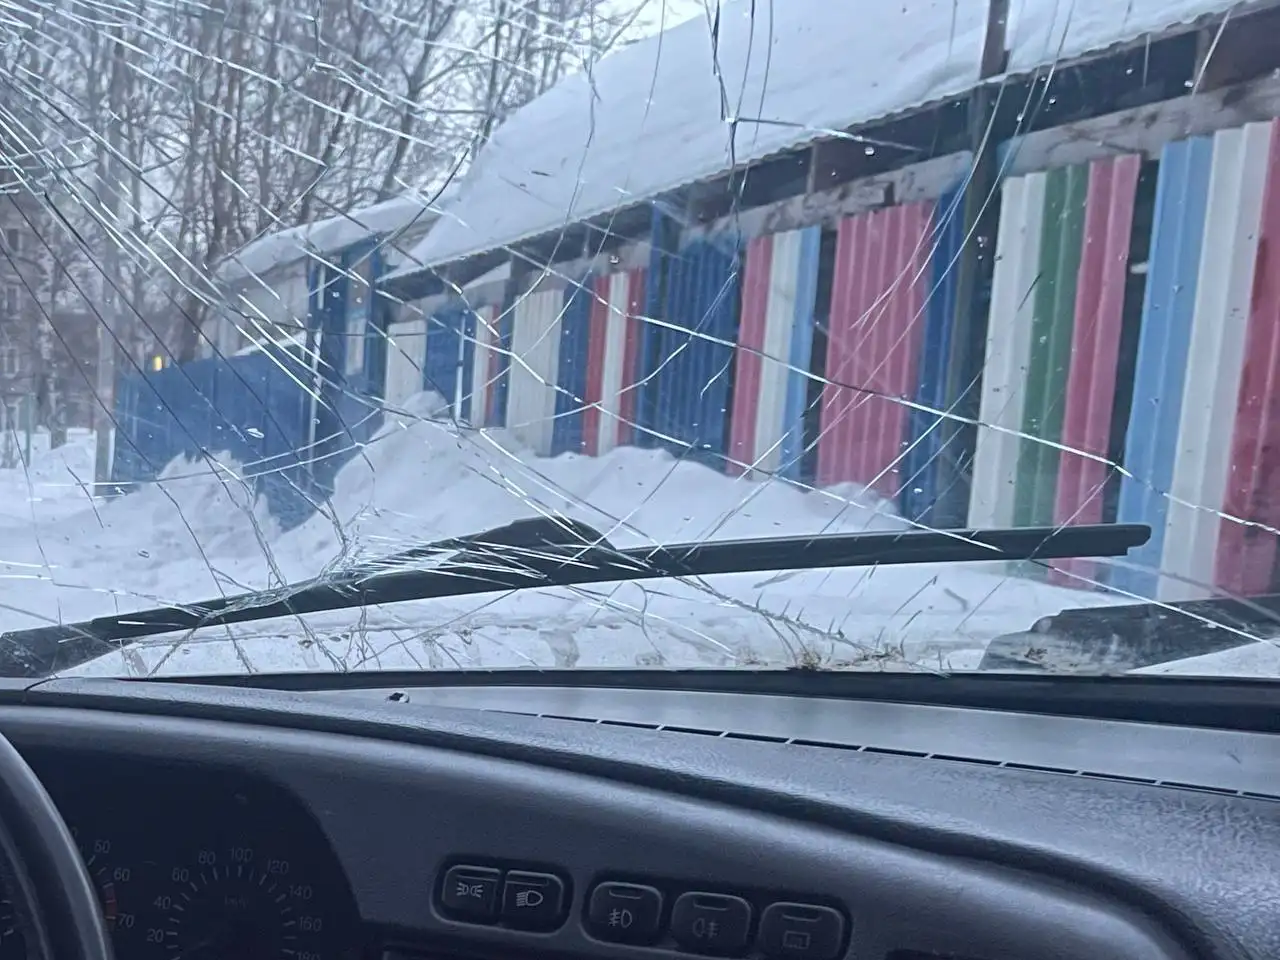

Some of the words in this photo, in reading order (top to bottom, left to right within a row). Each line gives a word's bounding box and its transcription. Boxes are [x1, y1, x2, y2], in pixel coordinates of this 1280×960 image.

[198, 851, 216, 865] 80
[230, 847, 253, 862] 100
[113, 867, 130, 881] 60
[267, 858, 289, 875] 120
[172, 868, 189, 882] 60
[289, 885, 313, 900] 140
[153, 895, 171, 910] 40
[119, 913, 135, 928] 70
[299, 916, 322, 931] 160
[147, 929, 164, 943] 20
